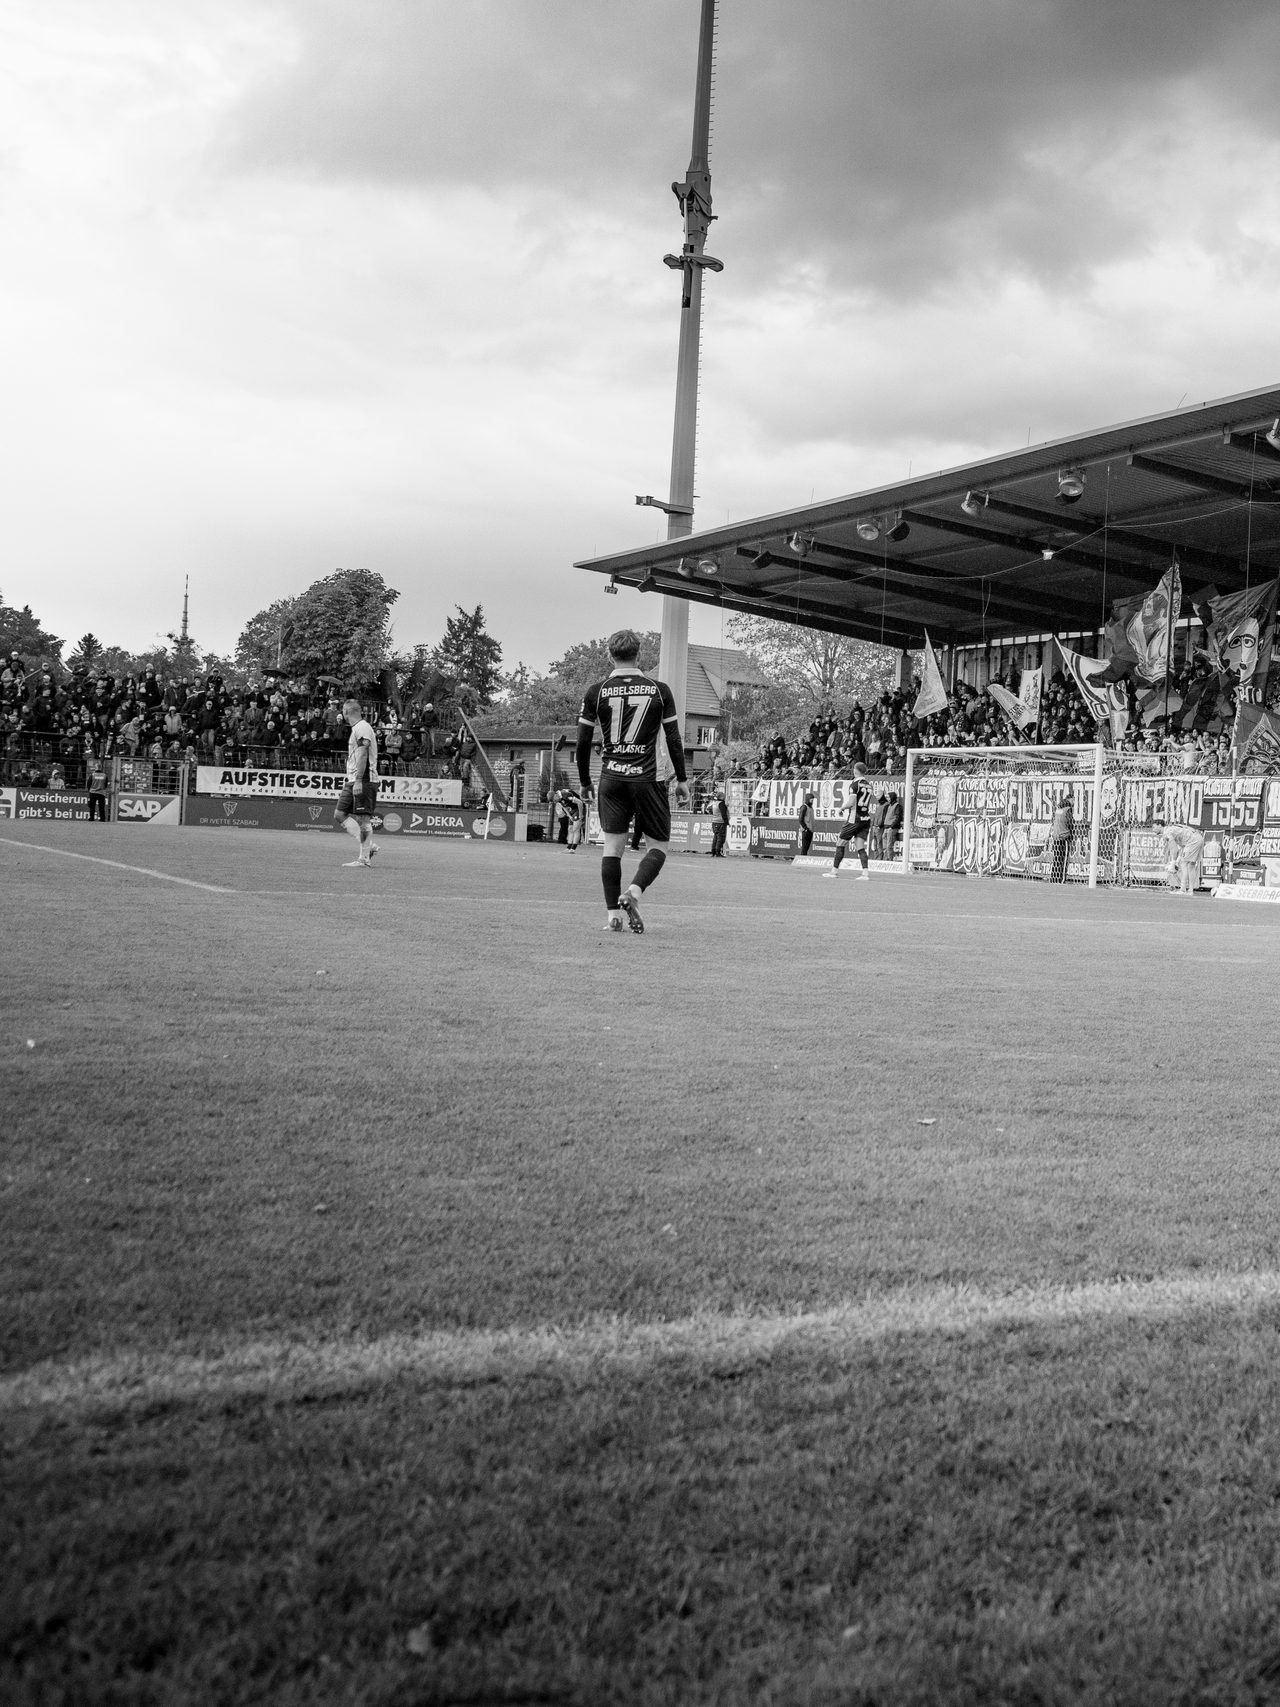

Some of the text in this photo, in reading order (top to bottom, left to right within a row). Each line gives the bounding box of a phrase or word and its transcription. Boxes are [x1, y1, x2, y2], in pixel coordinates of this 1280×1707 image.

[602, 685, 656, 698] BABELSBERG
[608, 696, 652, 744] 17
[607, 760, 643, 775] Katjes
[220, 771, 395, 793] AUFSTIEGSREM
[118, 799, 161, 818] SAP
[1124, 781, 1204, 826] INFERNO
[55, 808, 72, 819] bei
[427, 816, 464, 827] DEKRA
[731, 825, 747, 839] PRB
[759, 826, 797, 841] WESTMINSTER
